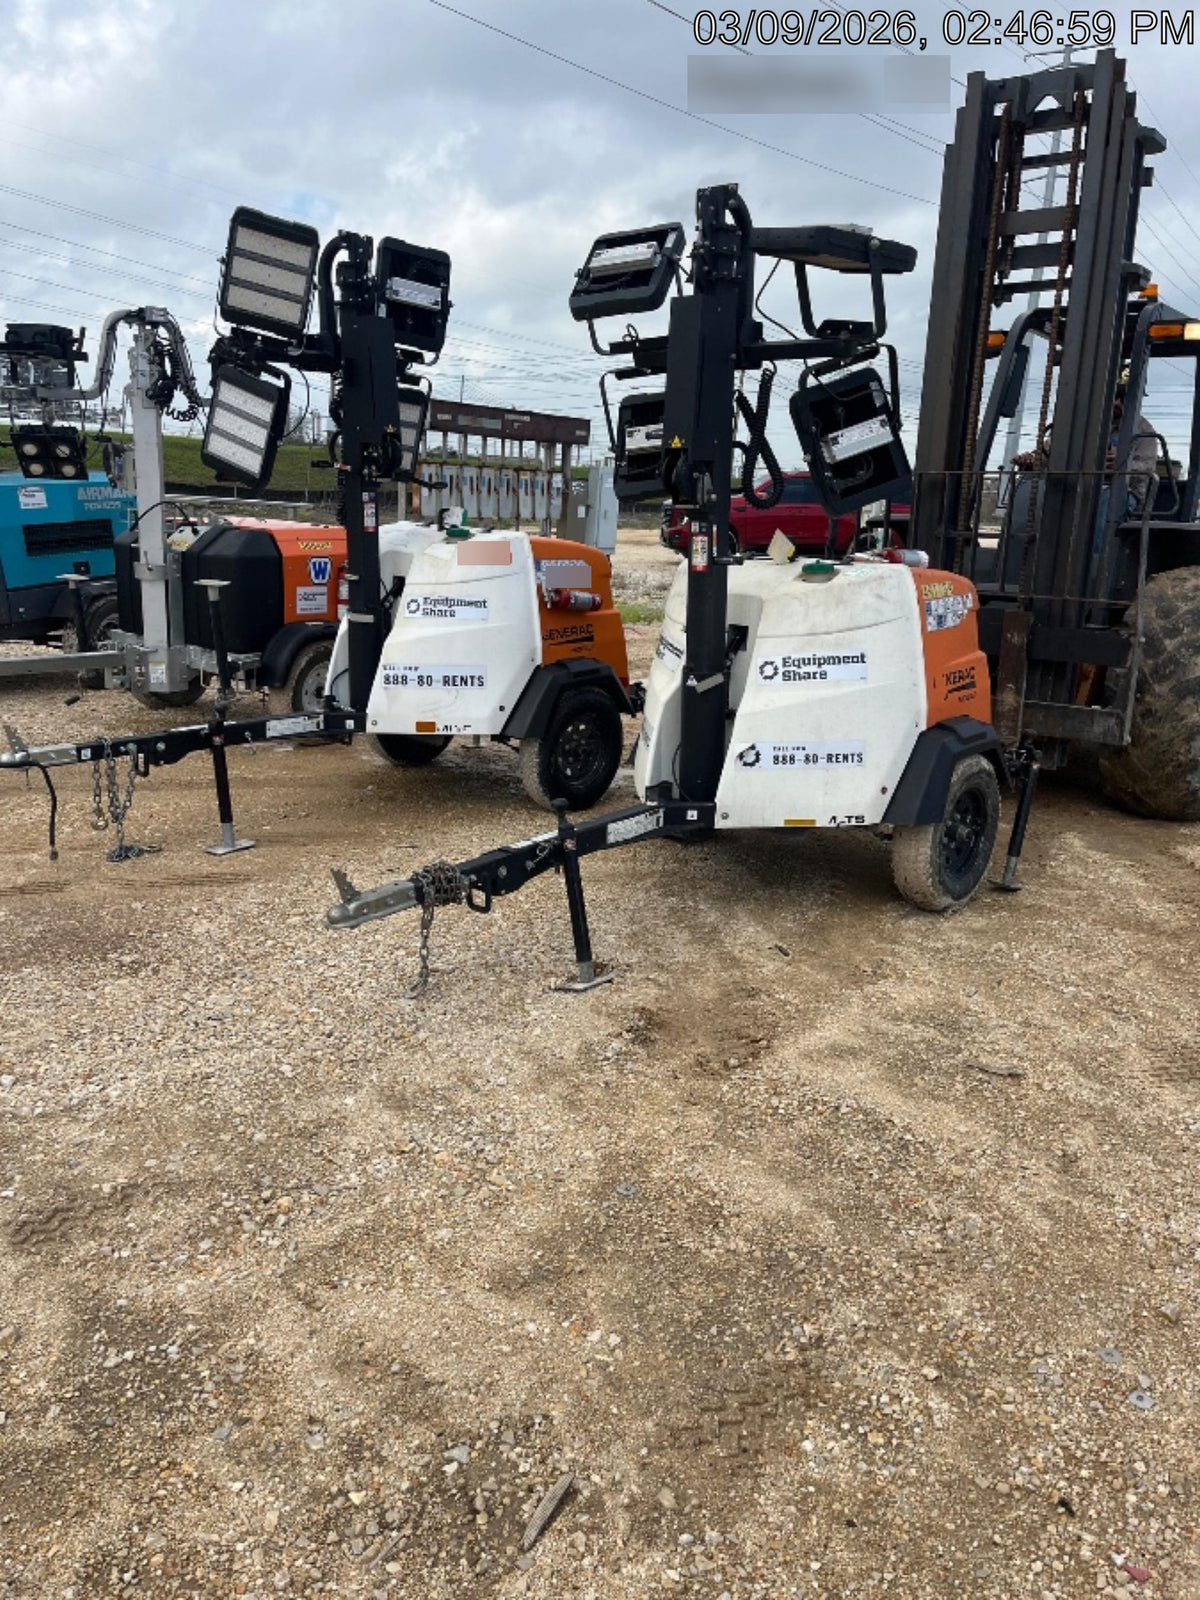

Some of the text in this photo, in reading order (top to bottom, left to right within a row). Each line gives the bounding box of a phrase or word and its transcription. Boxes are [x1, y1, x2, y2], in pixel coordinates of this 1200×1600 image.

[312, 561, 328, 580] W
[422, 596, 488, 609] Equipment
[421, 608, 456, 618] Share
[781, 652, 867, 669] Equipment
[383, 673, 485, 687] 888-80-RENTS
[781, 669, 828, 682] Share
[773, 752, 863, 766] 888-80-RENTS
